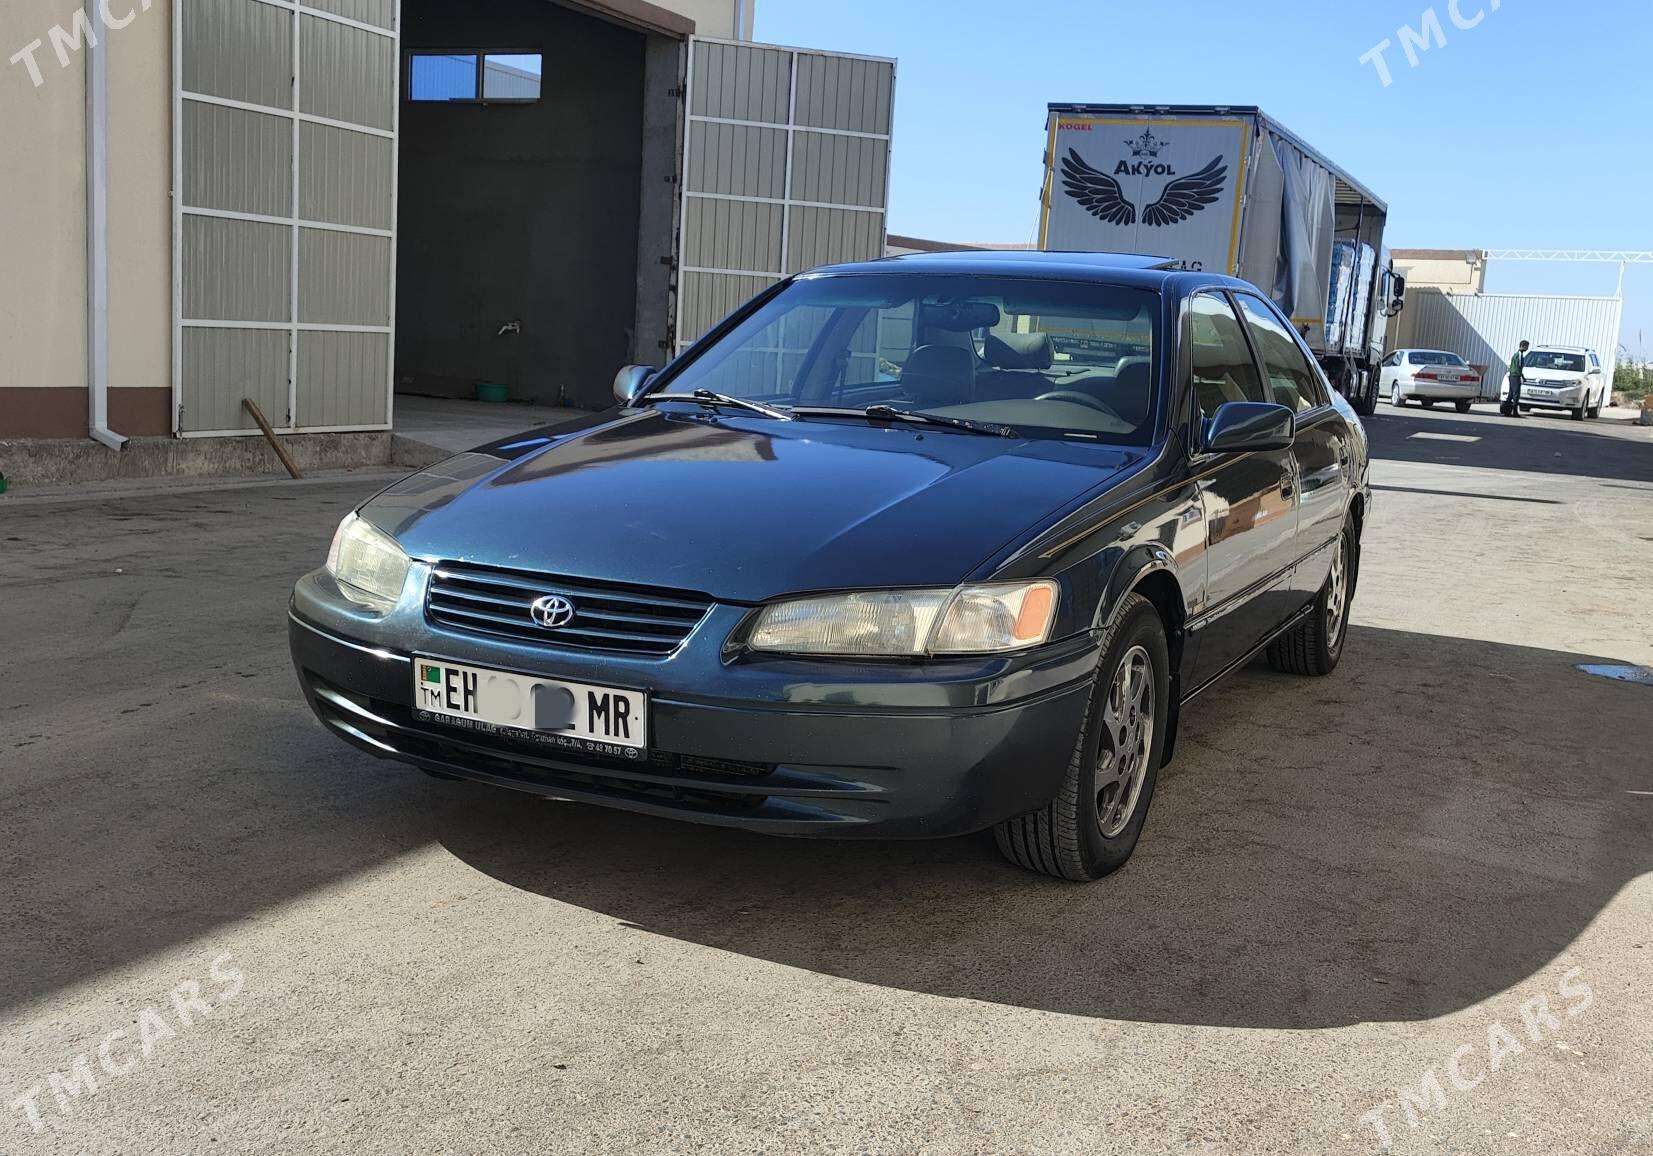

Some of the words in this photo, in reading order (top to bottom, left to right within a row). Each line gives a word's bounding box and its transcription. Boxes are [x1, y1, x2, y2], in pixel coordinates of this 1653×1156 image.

[420, 686, 441, 708] TM
[445, 668, 479, 713] EH
[587, 691, 630, 739] MR
